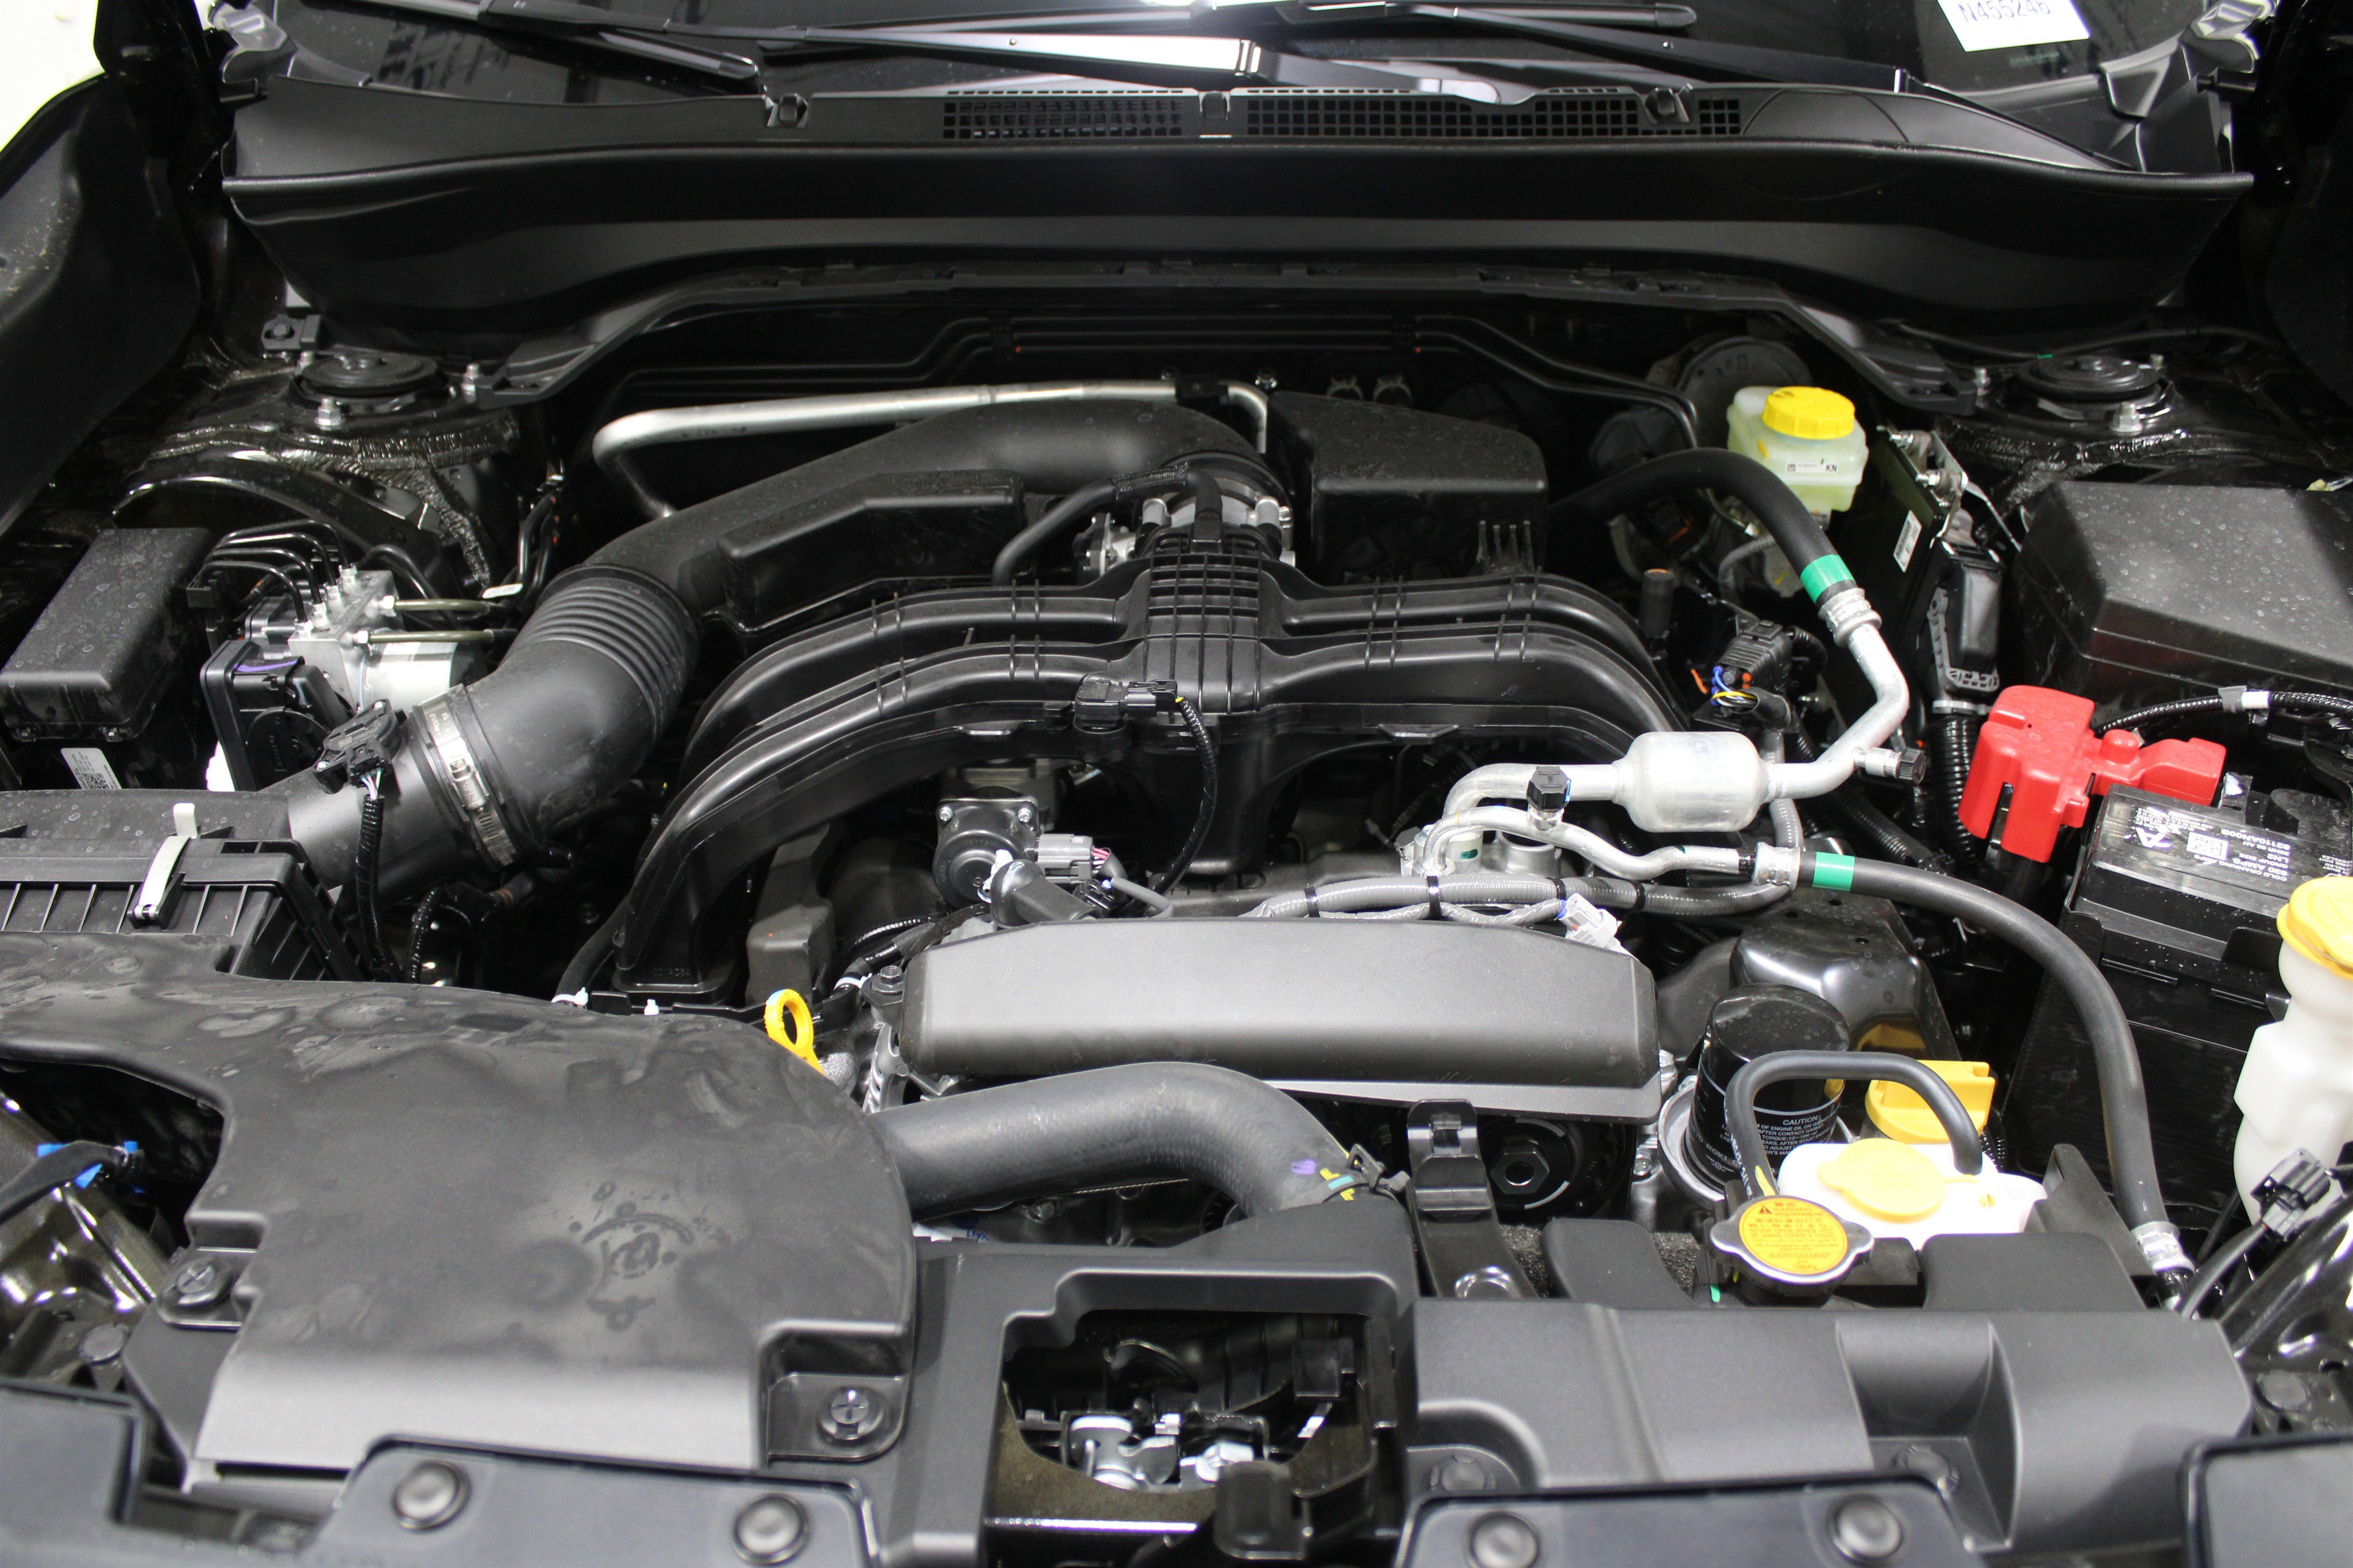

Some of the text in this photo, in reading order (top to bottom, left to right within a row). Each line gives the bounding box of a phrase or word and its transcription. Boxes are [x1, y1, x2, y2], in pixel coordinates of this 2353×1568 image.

[2266, 853, 2289, 863] LN2
[2267, 847, 2290, 856] 20HR
[2239, 852, 2288, 868] GROUP SIZE
[2219, 860, 2262, 875] CRANKING
[2232, 858, 2288, 876] 620 AMPS
[2263, 871, 2288, 882] COLD
[1783, 1115, 1818, 1125] CAUTION
[1706, 1143, 1727, 1161] ROKI
